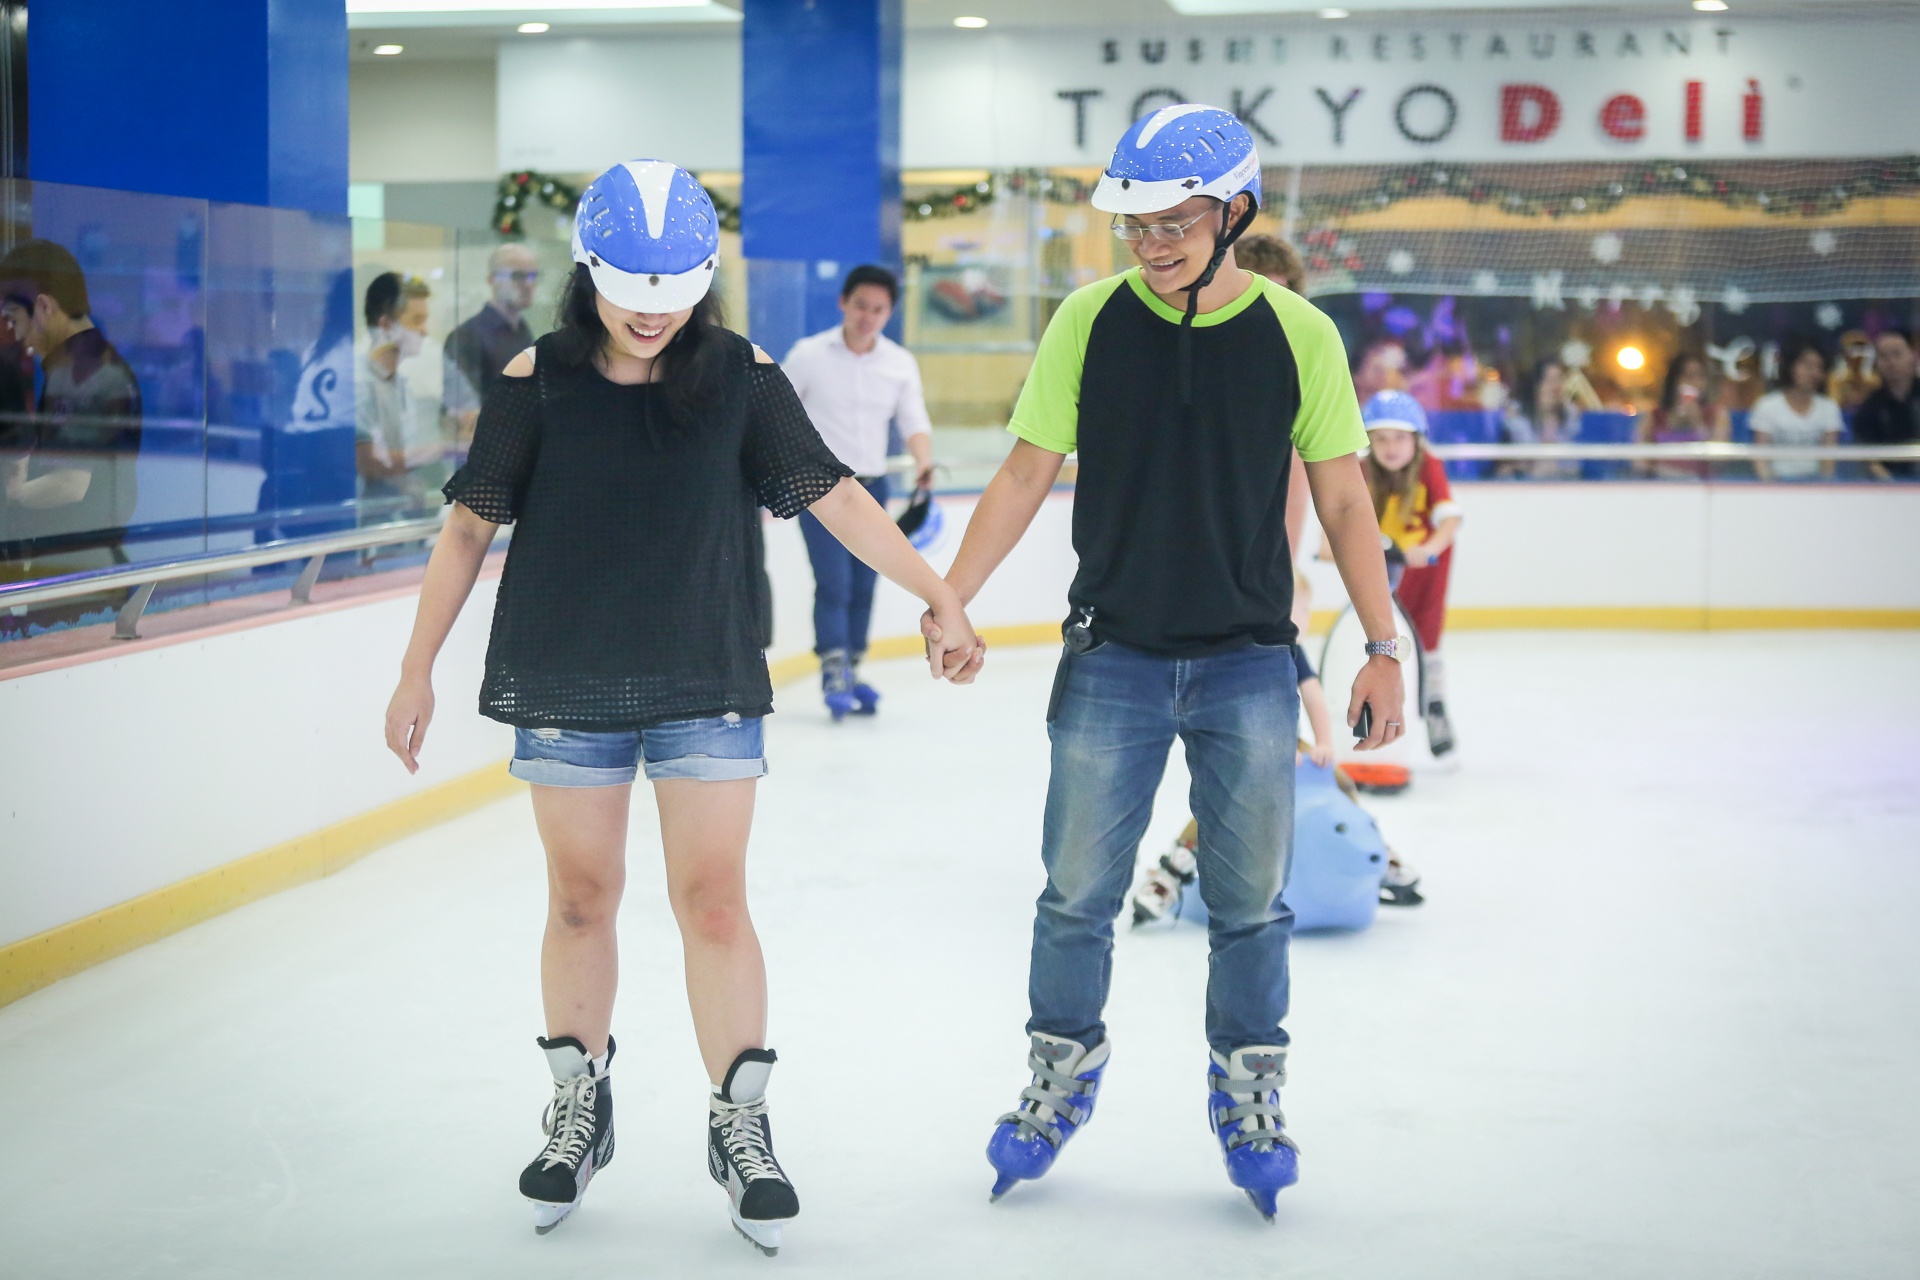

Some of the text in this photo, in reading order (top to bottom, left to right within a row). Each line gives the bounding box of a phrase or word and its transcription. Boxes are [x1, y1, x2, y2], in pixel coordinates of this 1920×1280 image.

[1103, 28, 1736, 64] SUSHI RESTAURANT
[1499, 77, 1763, 143] Deli
